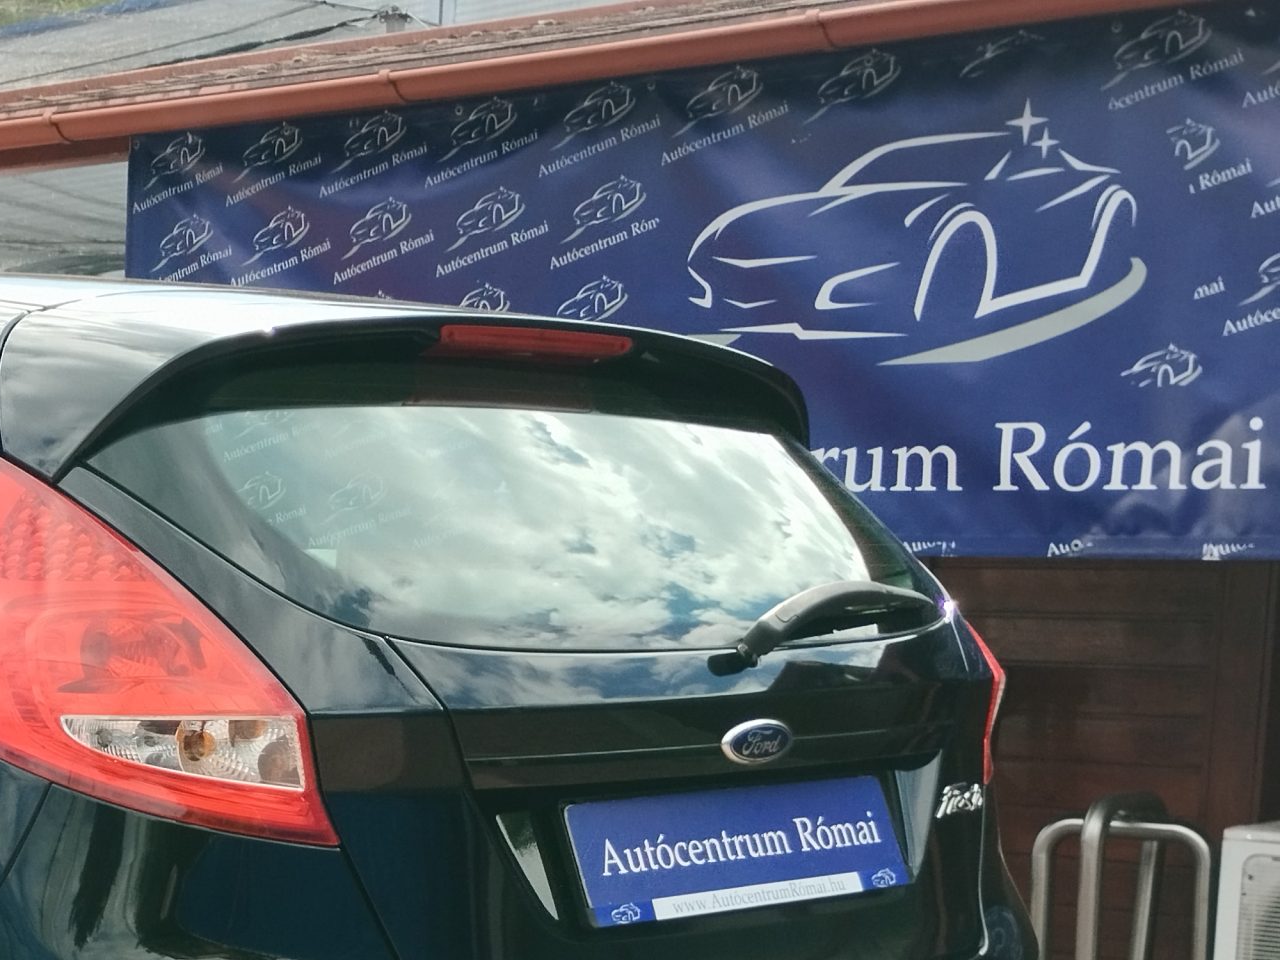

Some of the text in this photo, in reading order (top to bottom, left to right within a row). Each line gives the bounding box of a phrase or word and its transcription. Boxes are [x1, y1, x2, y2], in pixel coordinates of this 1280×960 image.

[424, 130, 539, 189] Autócentrum Római
[538, 114, 662, 178] Autócentrum Római
[660, 100, 789, 167] Autócentrum Római
[132, 163, 224, 214] Autócentrum Római
[225, 171, 285, 207] Autócentrum
[319, 141, 428, 199] Autócentrum Római
[200, 245, 232, 267] Római
[301, 237, 331, 261] Római
[333, 229, 435, 285] Autócentrum Római
[435, 220, 549, 278] Autócentrum Római
[549, 231, 629, 270] Autócentrum
[992, 416, 1267, 493] Római
[742, 729, 782, 756] Ford
[602, 811, 882, 876] Autócentrum Római
